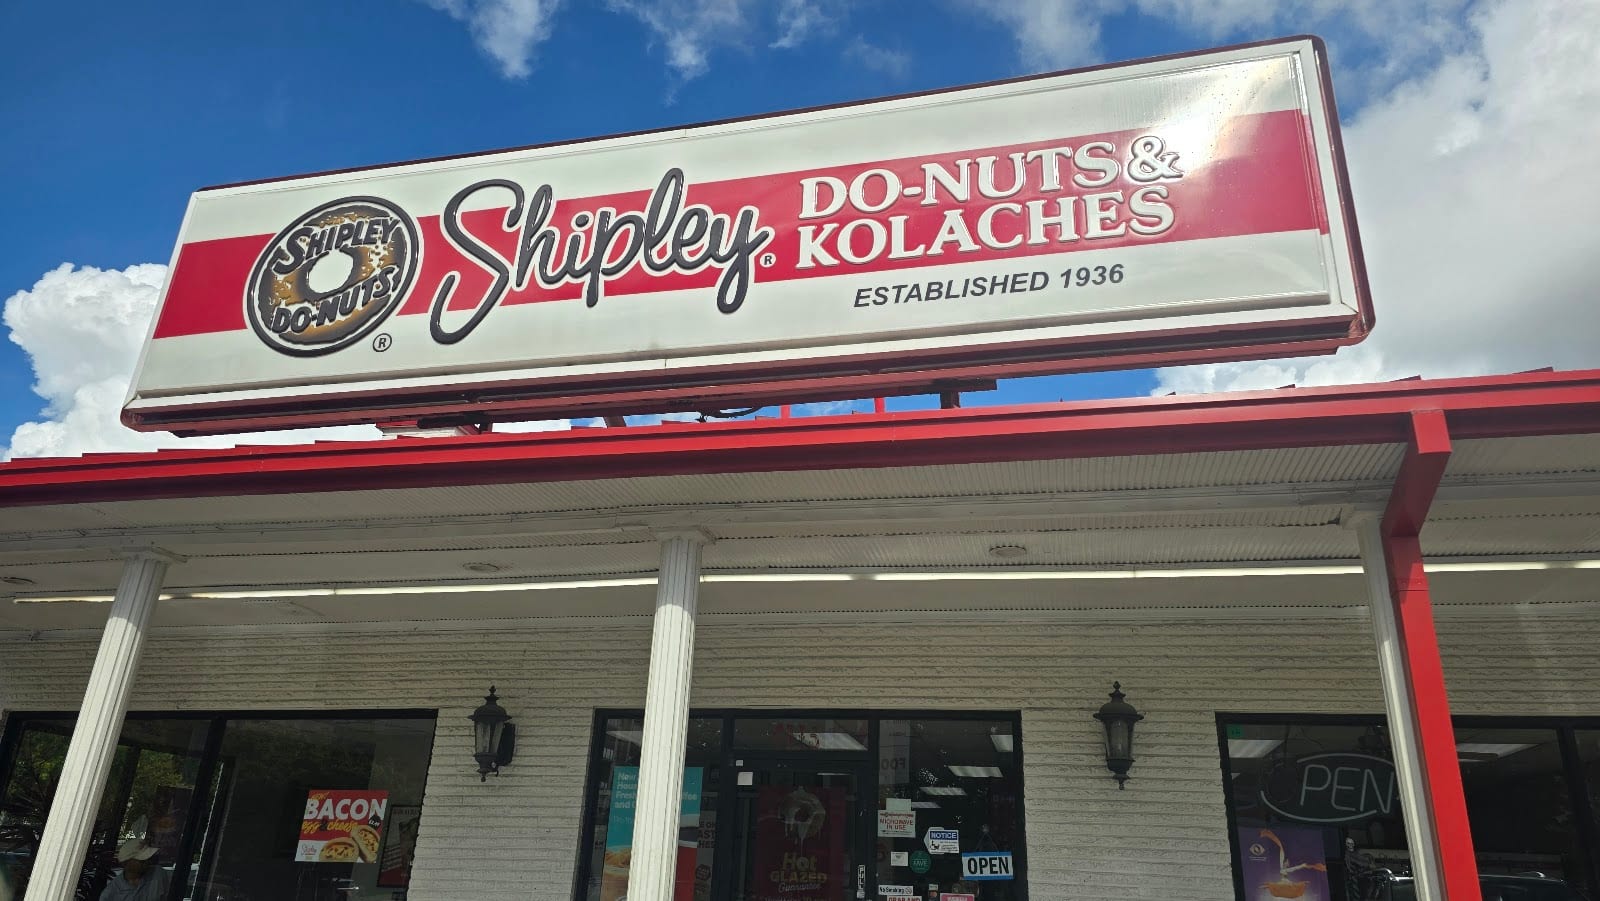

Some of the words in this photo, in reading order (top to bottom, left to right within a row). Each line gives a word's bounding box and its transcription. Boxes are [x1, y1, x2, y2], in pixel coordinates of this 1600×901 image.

[797, 140, 1121, 220] DO-NUTS
[1126, 134, 1184, 183] &
[273, 217, 400, 274] SHIPLEY
[795, 184, 1176, 270] KOLACHES
[429, 167, 770, 345] Shipley
[272, 265, 399, 333] DO-NUTS
[853, 270, 1050, 309] ESTABLISHED
[1060, 263, 1125, 290] 1936
[303, 798, 388, 821] BACON
[1267, 764, 1395, 814] PEN
[967, 856, 1010, 875] OPEN
